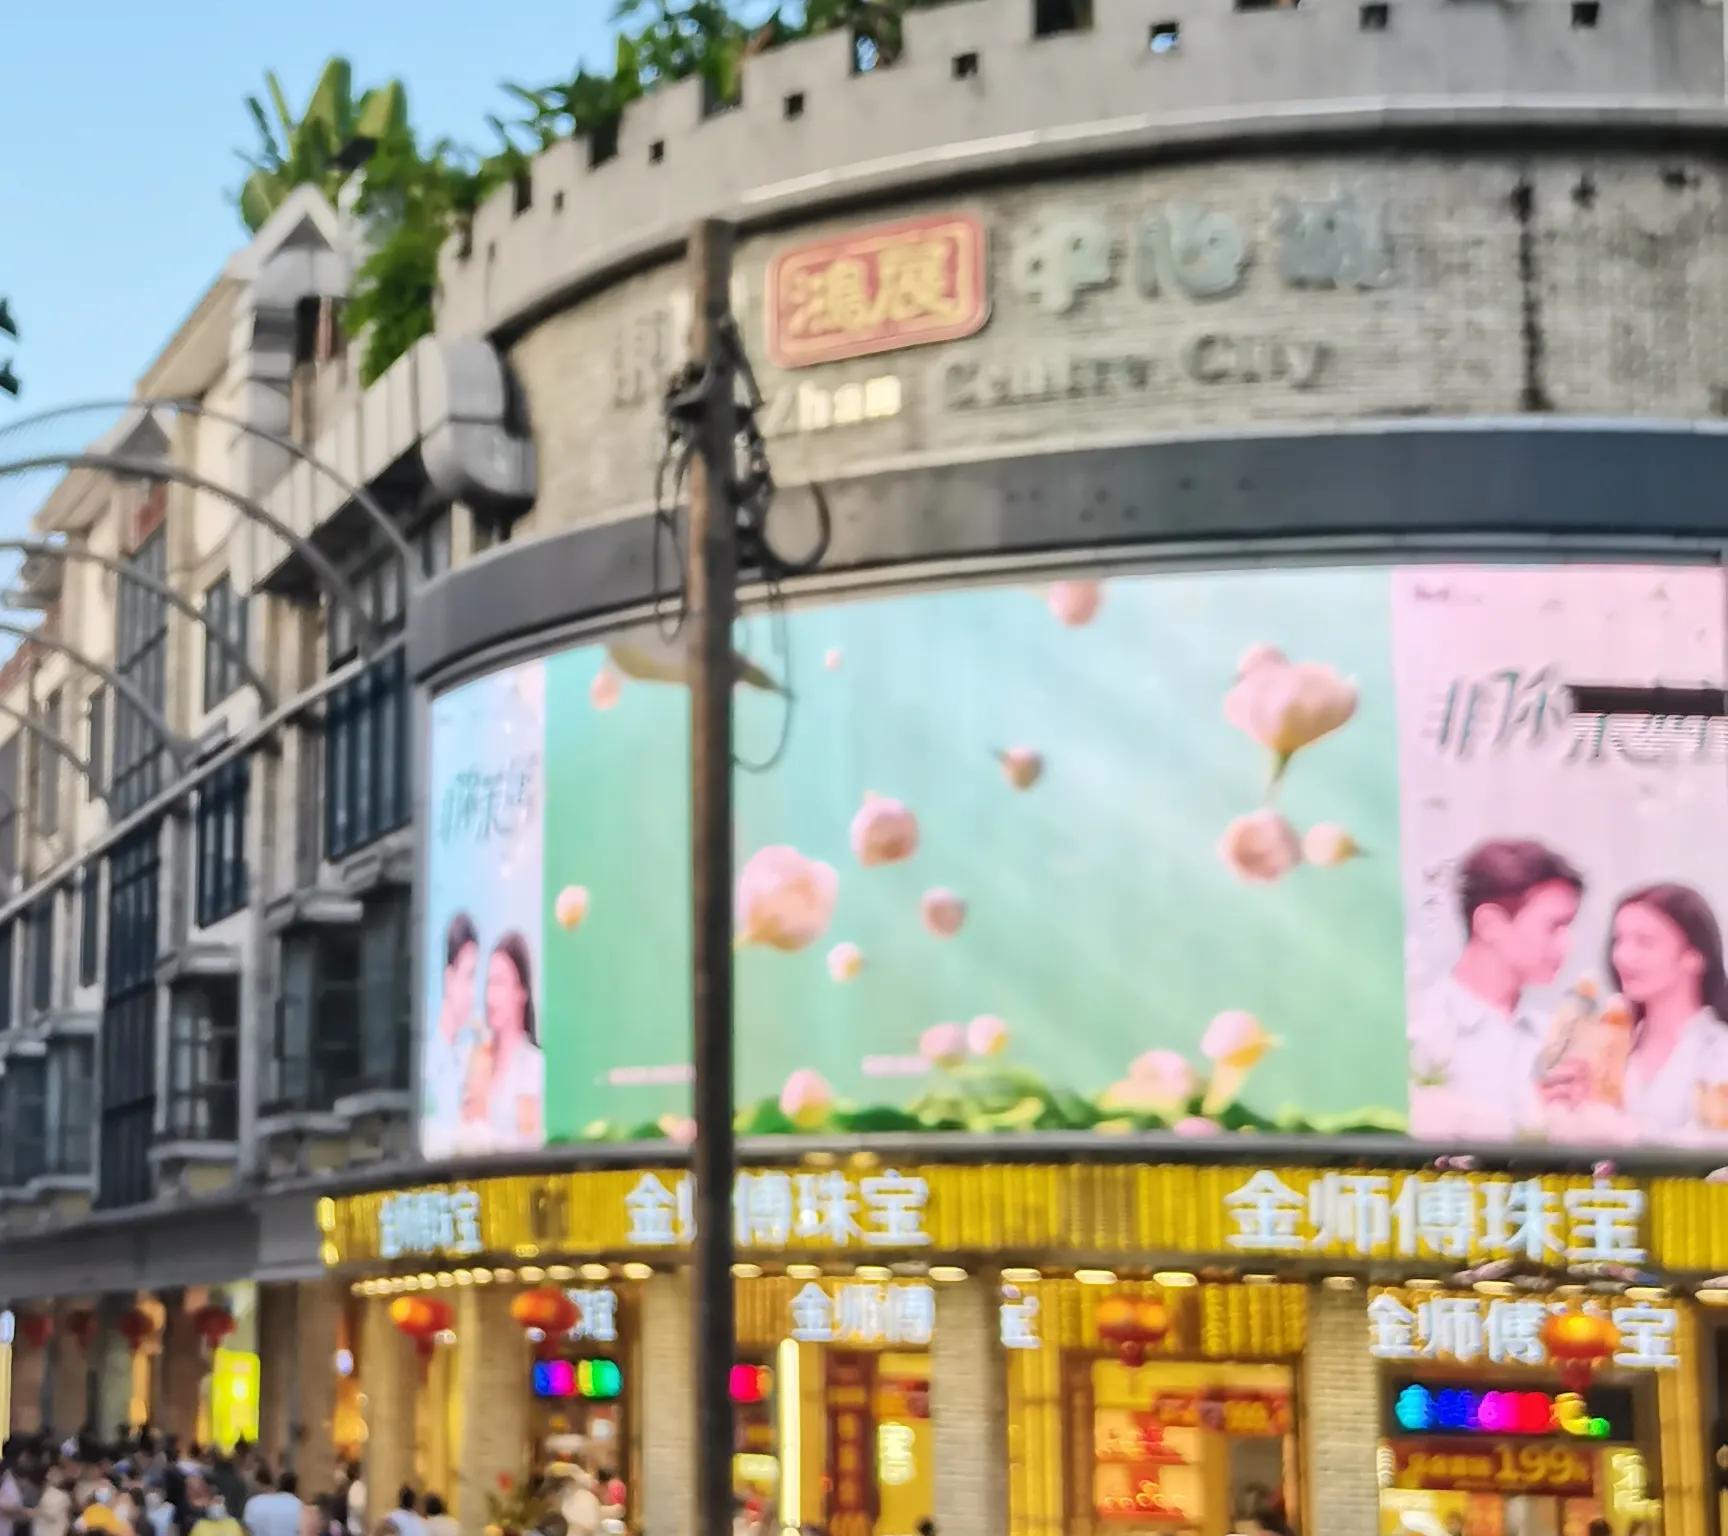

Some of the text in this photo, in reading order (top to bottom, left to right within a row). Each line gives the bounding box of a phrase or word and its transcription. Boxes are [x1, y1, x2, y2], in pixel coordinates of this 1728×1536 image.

[1224, 1169, 1648, 1263] 金师傅珠宝
[1367, 1293, 1680, 1368] 金师傅宝
